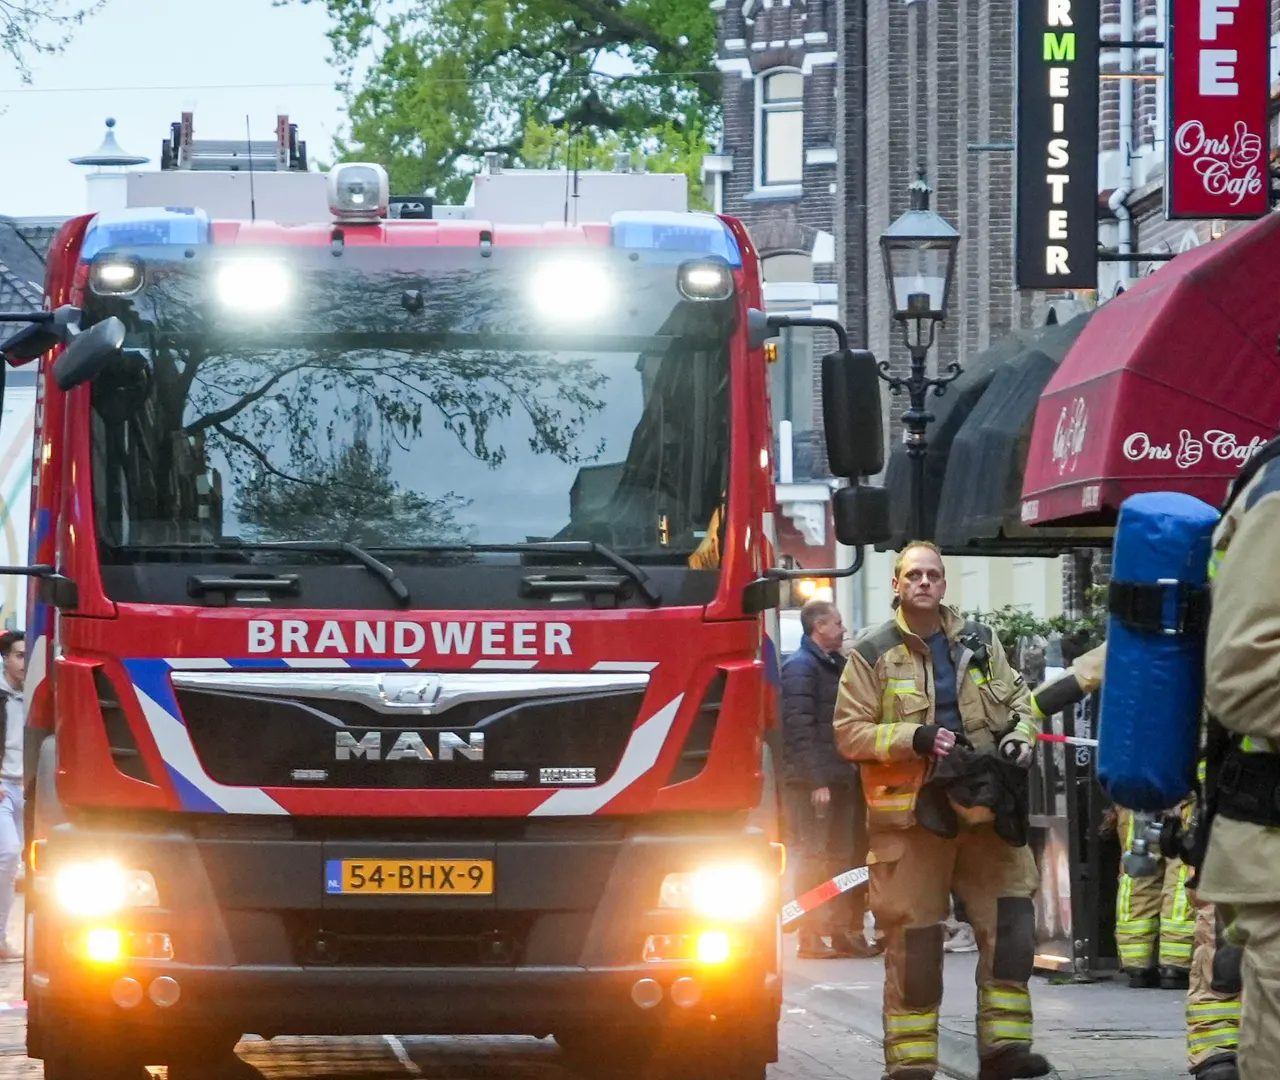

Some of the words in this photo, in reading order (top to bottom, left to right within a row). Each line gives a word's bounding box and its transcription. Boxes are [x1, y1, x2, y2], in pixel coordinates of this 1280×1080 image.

[1175, 119, 1232, 156] Ons
[1193, 156, 1263, 206] Café
[1122, 431, 1173, 461] Ons
[247, 619, 574, 656] BRANDWEER
[335, 731, 485, 761] MAN
[327, 880, 340, 888] NL
[350, 864, 484, 889] 54-BHX-9
